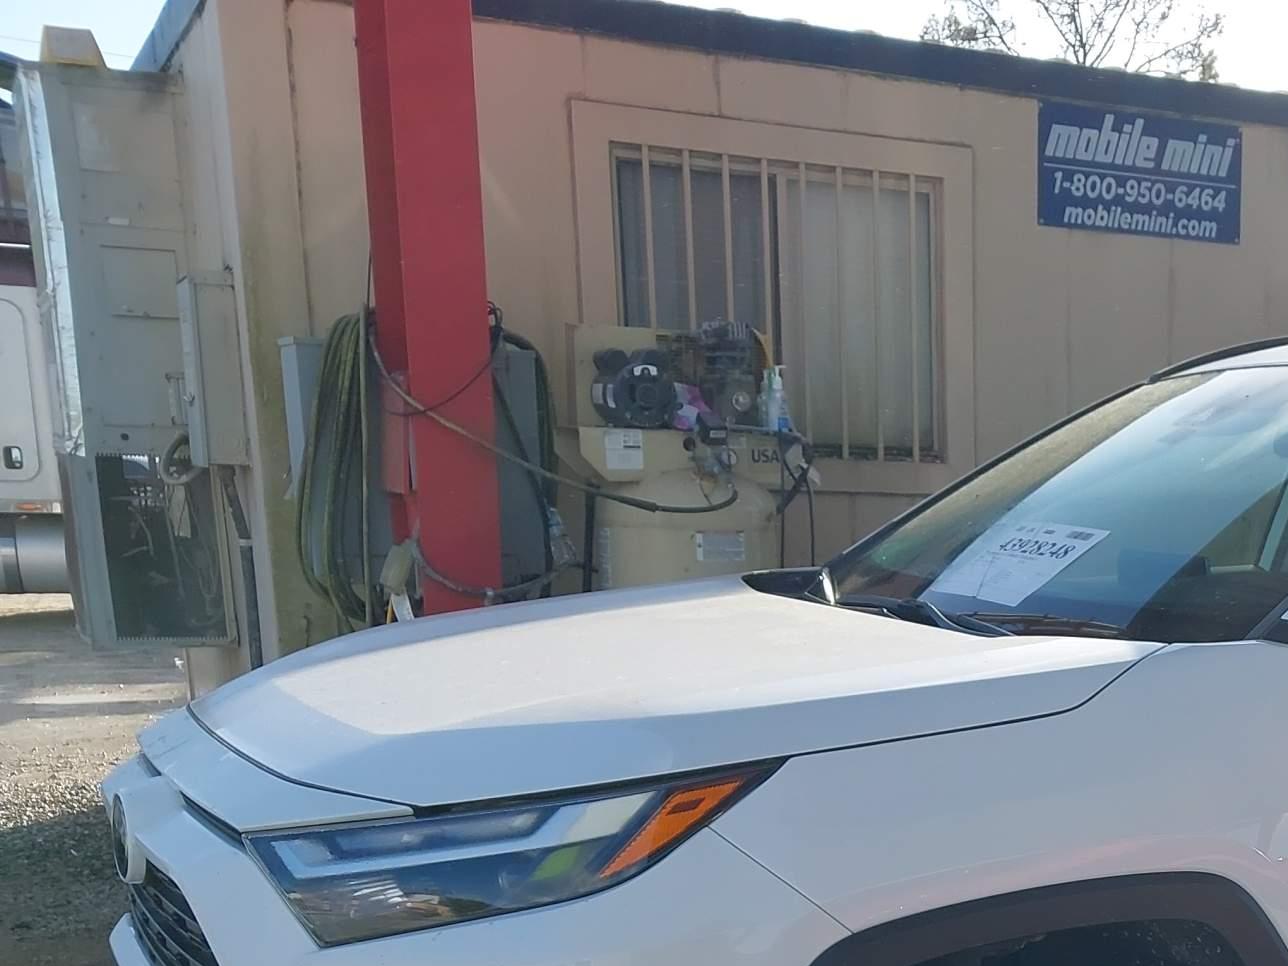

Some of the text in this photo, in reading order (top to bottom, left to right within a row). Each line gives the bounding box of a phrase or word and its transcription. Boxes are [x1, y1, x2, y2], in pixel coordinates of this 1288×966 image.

[1045, 114, 1235, 177] mobile mini
[1053, 171, 1226, 212] 1-800-950-6464
[1064, 205, 1217, 238] mobilemini.com
[752, 448, 779, 463] USA
[999, 537, 1077, 560] 43928248
